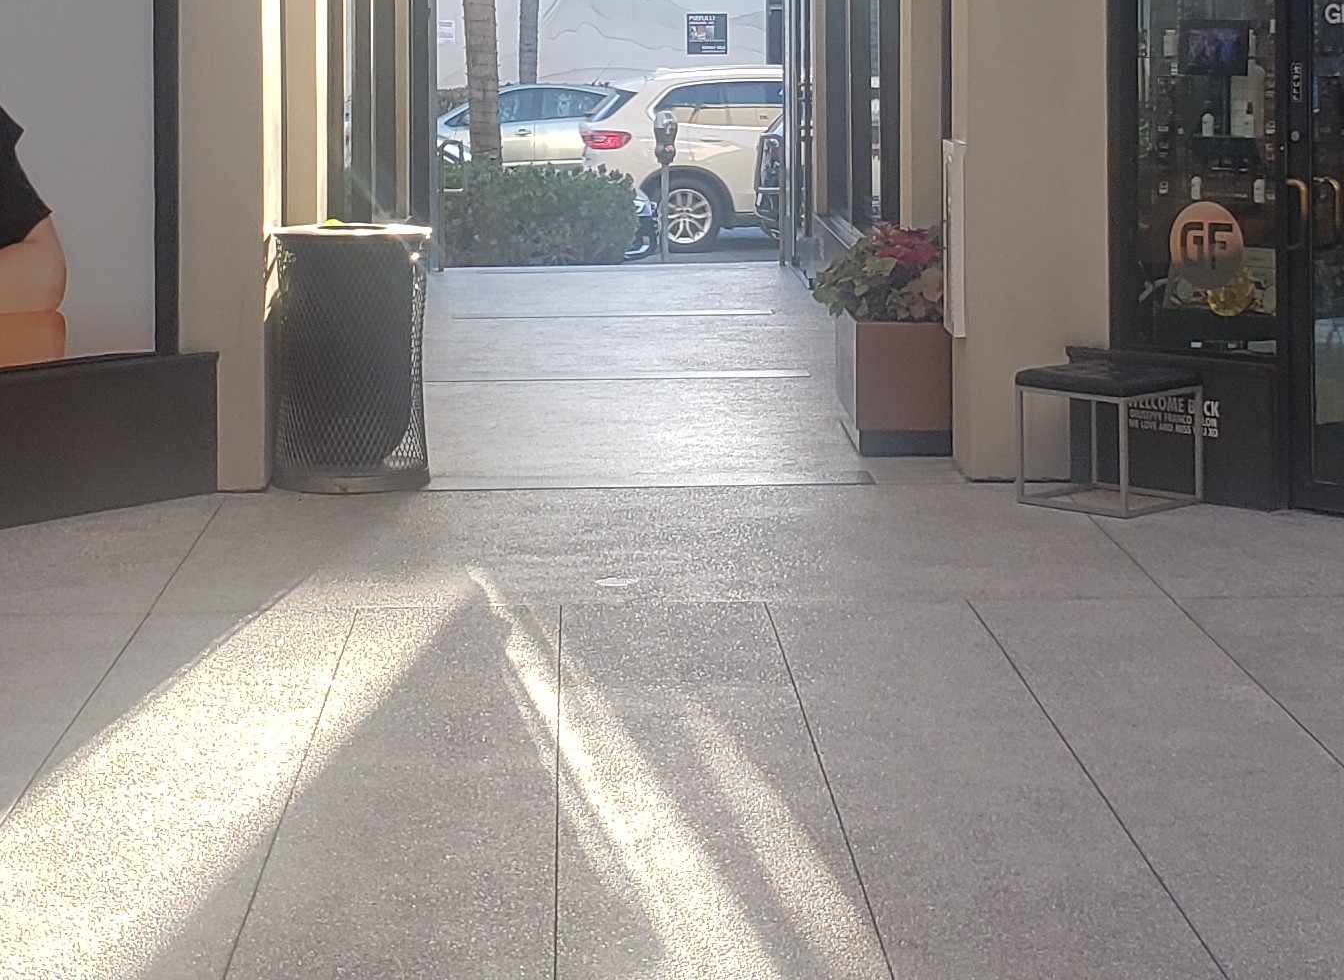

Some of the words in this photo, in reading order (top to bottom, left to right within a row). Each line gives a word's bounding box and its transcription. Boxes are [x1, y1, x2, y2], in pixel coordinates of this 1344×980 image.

[1292, 75, 1300, 101] PULL
[1188, 399, 1220, 418] BCK
[1175, 424, 1192, 434] MISS
